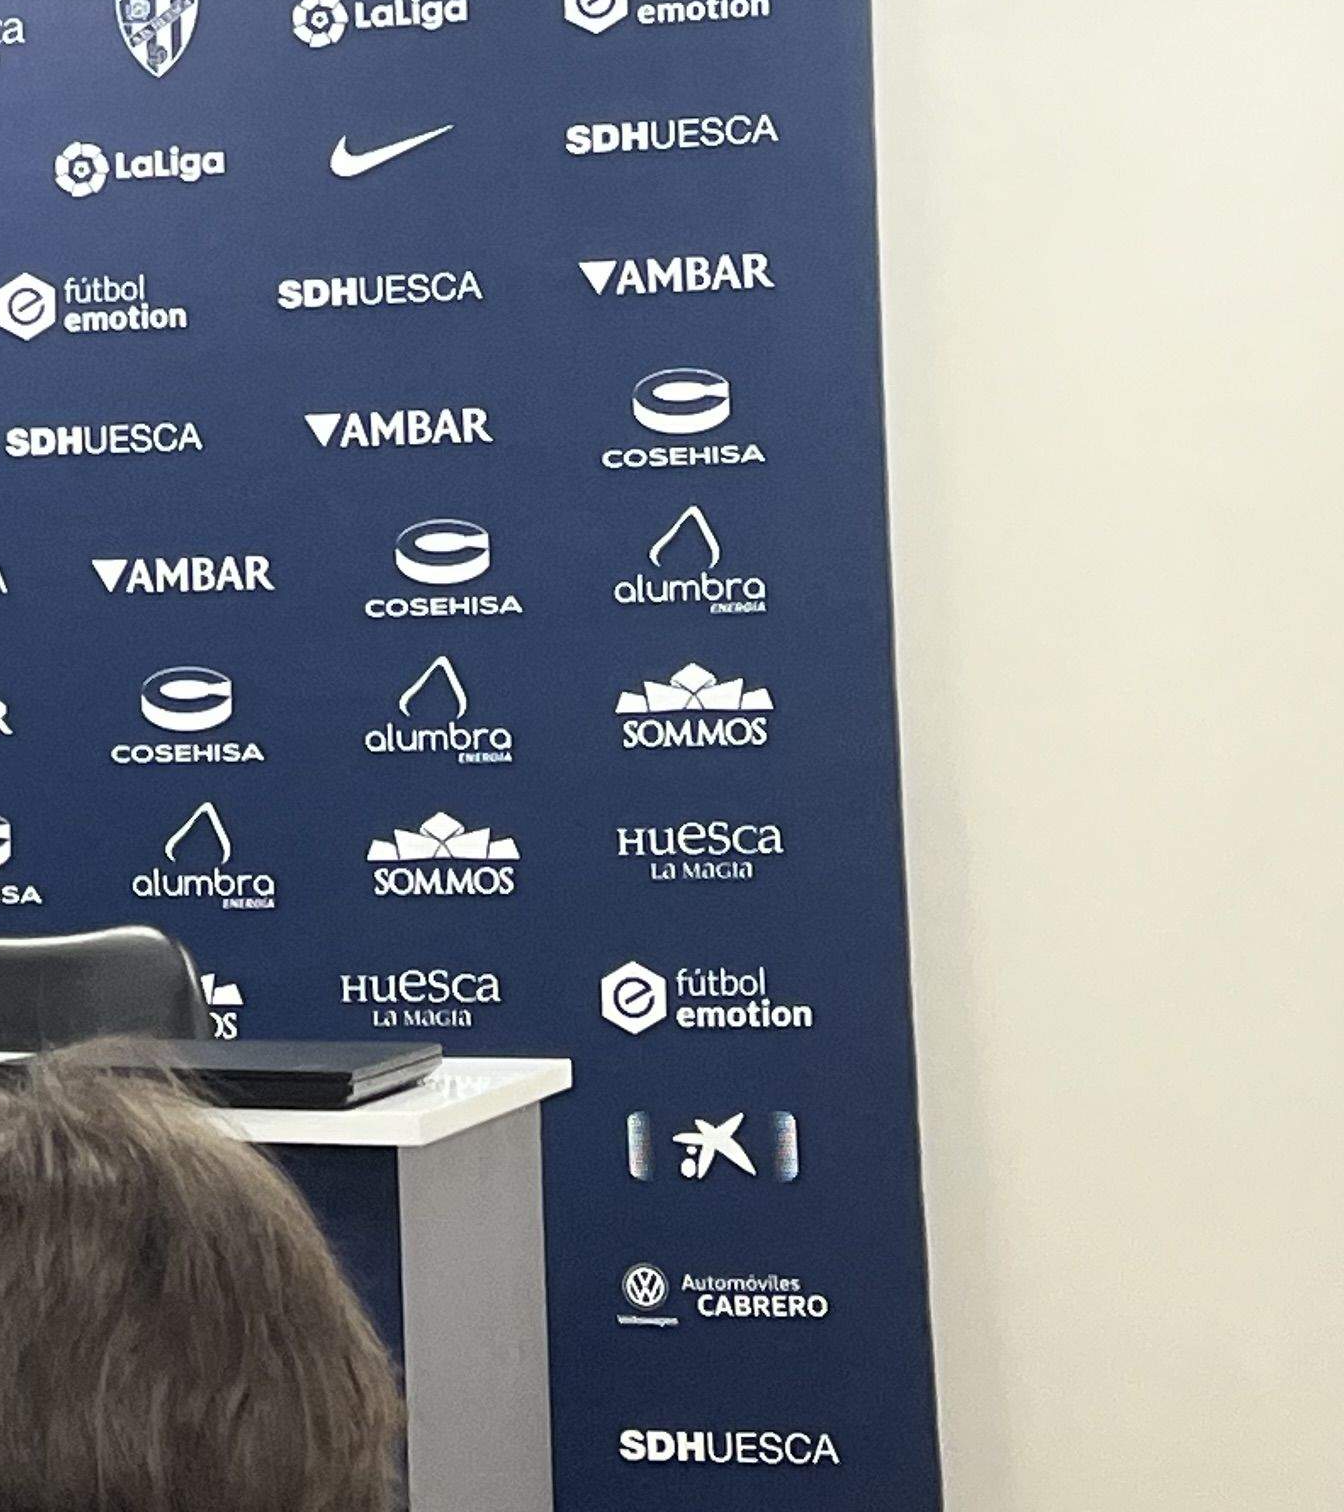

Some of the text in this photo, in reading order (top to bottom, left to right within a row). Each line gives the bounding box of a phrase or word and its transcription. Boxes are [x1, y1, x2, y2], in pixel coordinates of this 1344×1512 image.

[115, 146, 225, 181] LaLiga
[64, 274, 145, 303] fútbol
[616, 253, 775, 295] AMBAR
[64, 302, 187, 332] emotion
[340, 408, 493, 448] AMBAR
[602, 444, 765, 468] COSEHISA
[126, 556, 275, 593] AMBAR
[614, 572, 765, 603] alumbra
[365, 595, 523, 617] COSEHISA
[365, 721, 512, 752] alumbra
[623, 717, 767, 748] SOMMOS
[111, 743, 264, 763] COSEHISA
[133, 867, 274, 896] alumbra
[374, 867, 514, 896] SOMMOS
[676, 967, 765, 996] fútbol
[676, 998, 812, 1028] emotion
[698, 1294, 828, 1317] CABRERO
